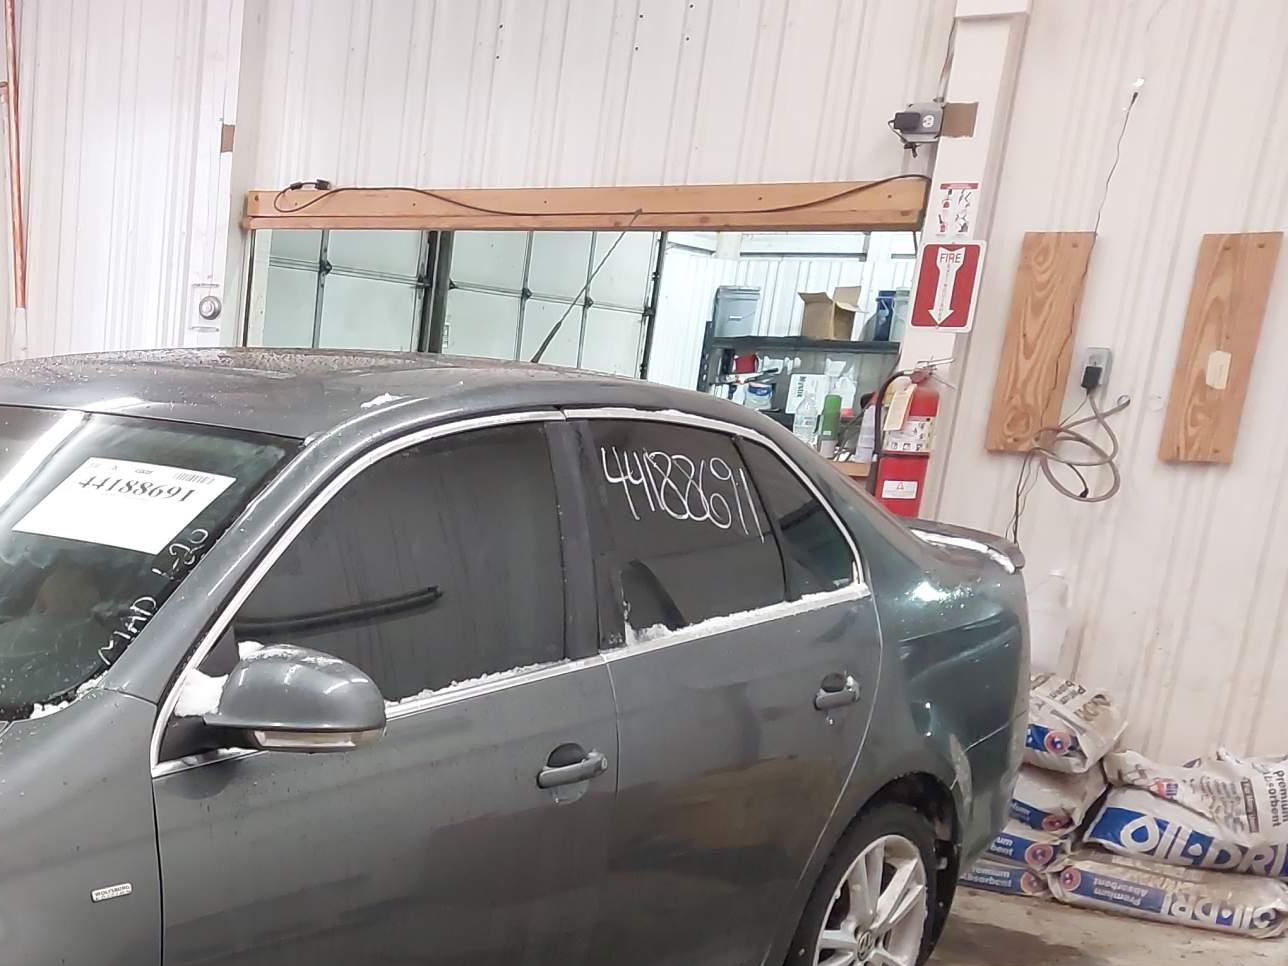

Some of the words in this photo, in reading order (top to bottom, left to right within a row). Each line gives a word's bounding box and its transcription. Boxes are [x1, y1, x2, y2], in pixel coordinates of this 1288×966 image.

[940, 253, 962, 264] FIRE
[78, 475, 196, 502] 44188691
[601, 446, 765, 544] 44188691
